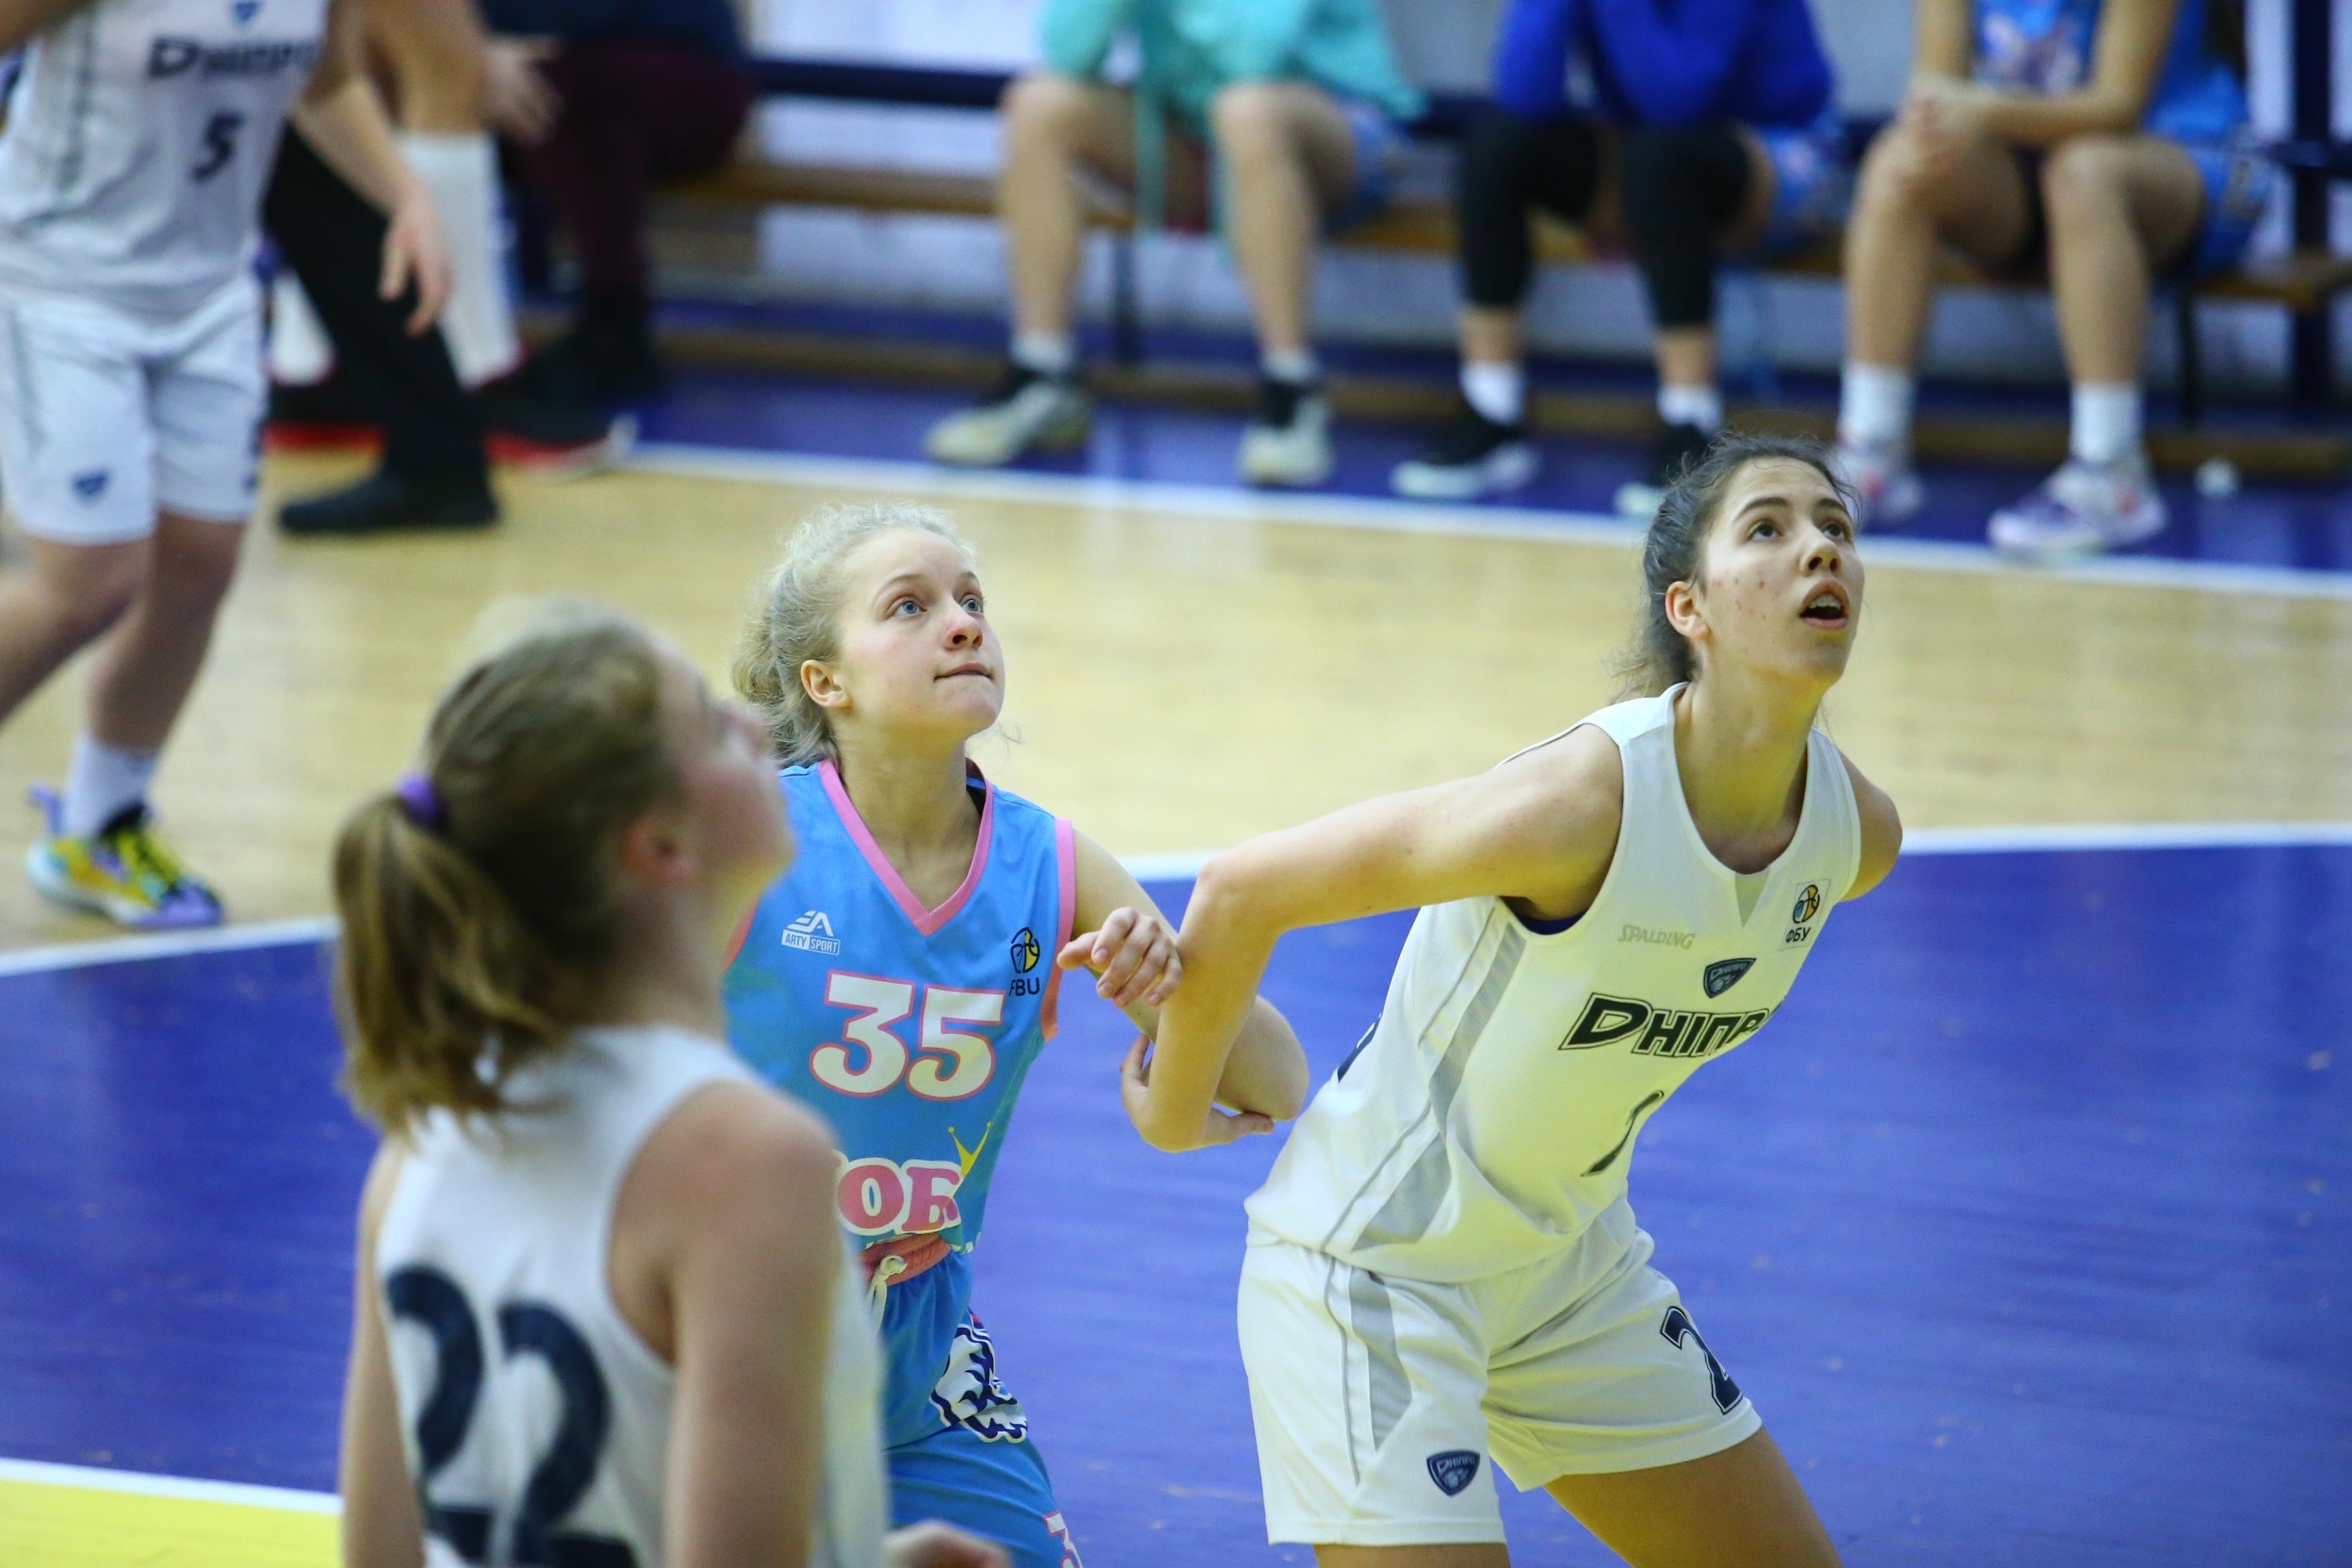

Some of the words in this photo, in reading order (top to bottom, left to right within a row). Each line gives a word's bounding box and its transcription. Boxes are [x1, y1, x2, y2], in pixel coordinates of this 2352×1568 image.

[190, 111, 243, 182] 5
[785, 932, 808, 948] ARTY
[810, 938, 838, 953] SPORT
[1618, 924, 1697, 950] SPALDING
[1009, 977, 1040, 996] FBU
[809, 969, 1007, 1101] 35
[385, 1260, 638, 1568] 22
